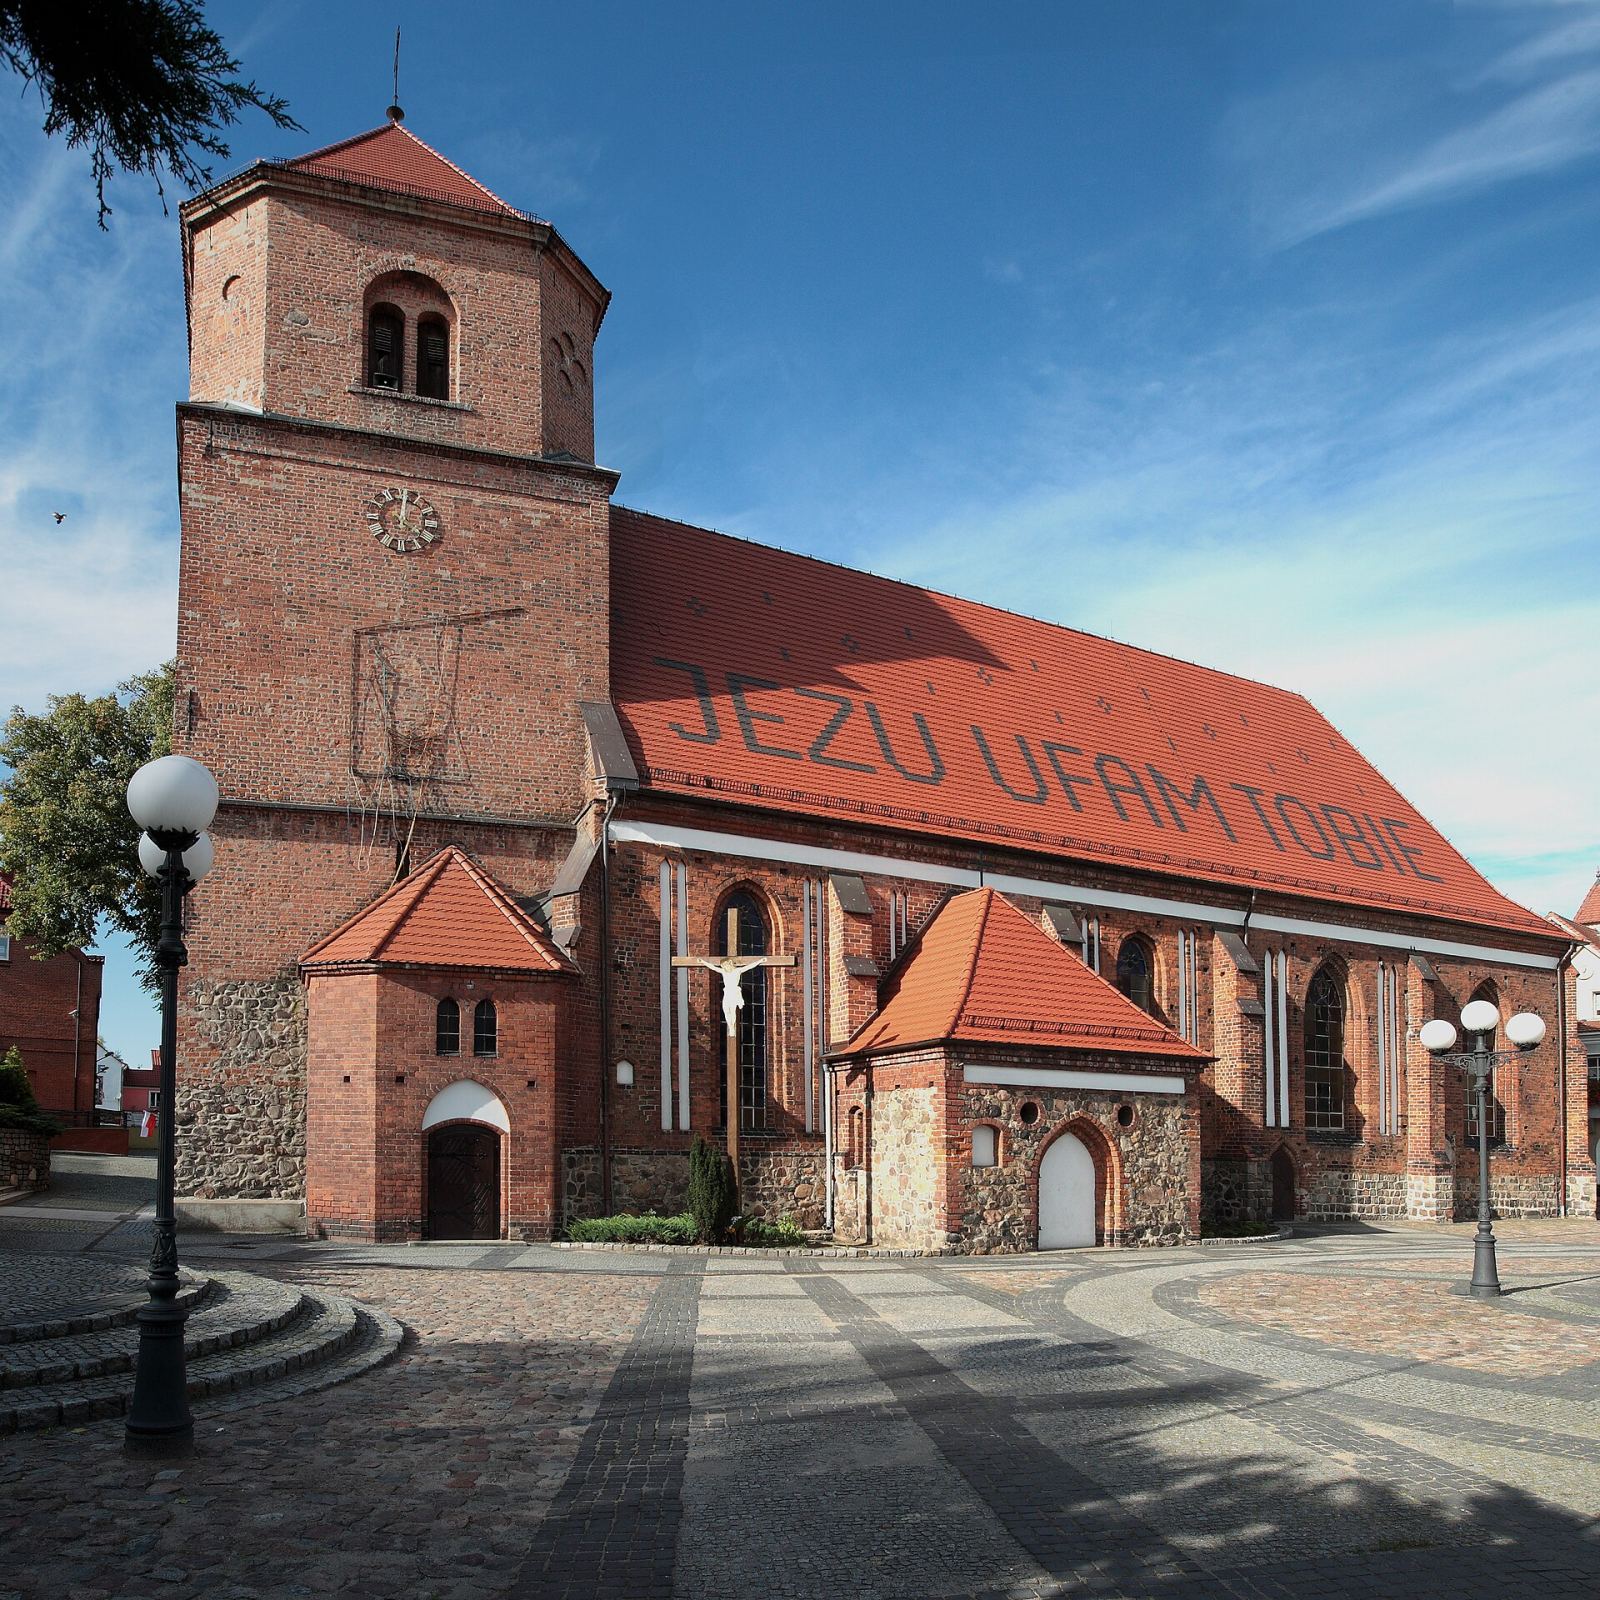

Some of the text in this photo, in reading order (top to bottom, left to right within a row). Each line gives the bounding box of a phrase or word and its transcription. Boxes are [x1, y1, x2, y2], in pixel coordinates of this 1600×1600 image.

[653, 656, 1445, 884] JEZU UFAM TOBIE
